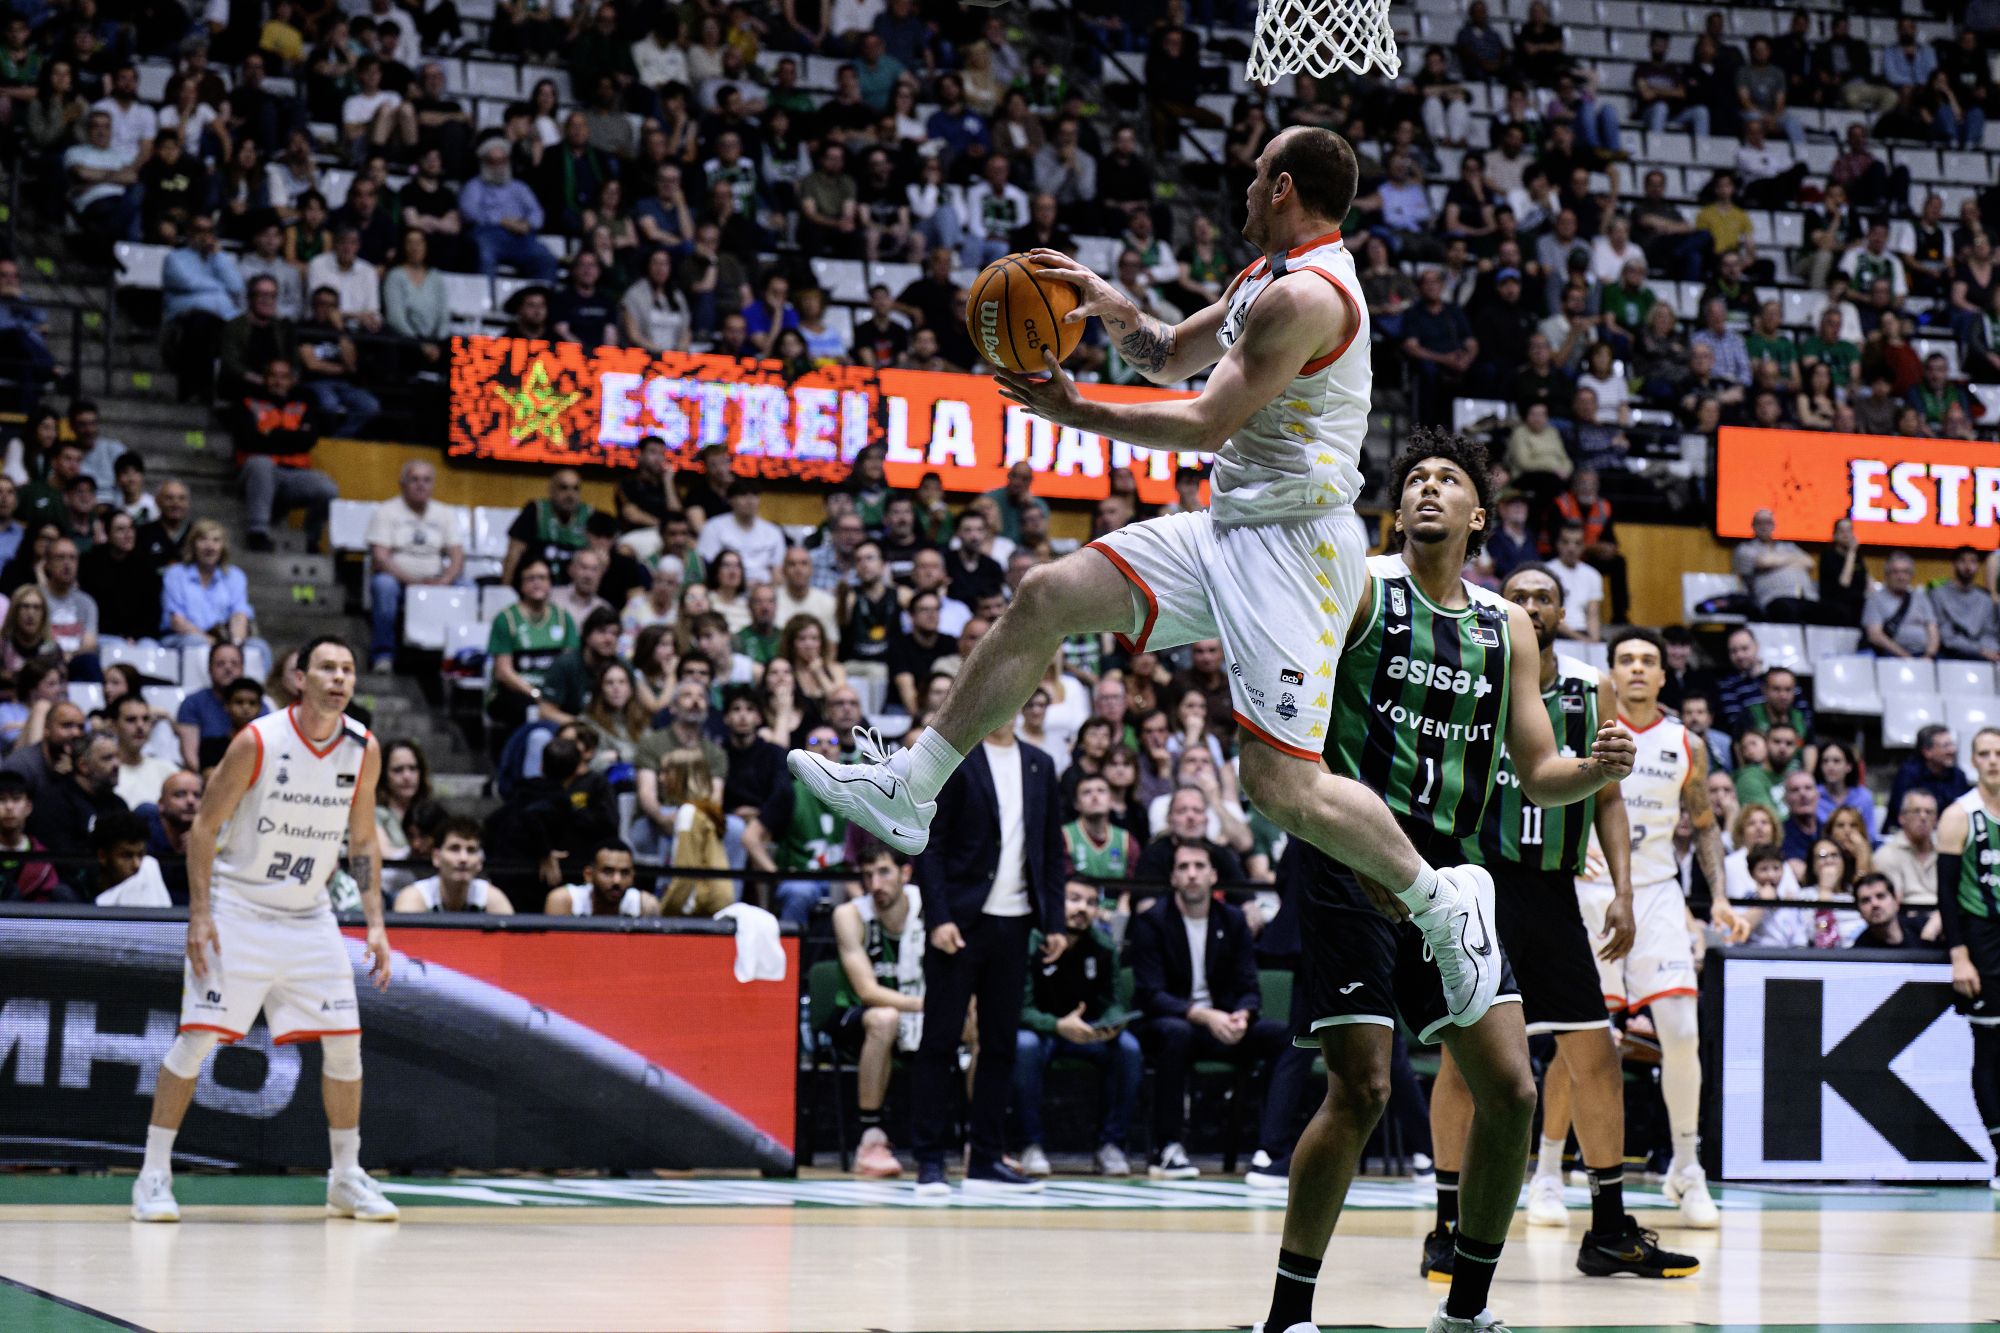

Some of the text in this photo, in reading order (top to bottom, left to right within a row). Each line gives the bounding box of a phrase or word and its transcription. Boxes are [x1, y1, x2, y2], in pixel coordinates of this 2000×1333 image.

[1023, 319, 1041, 349] acb
[1004, 405, 1214, 480] DA
[1281, 674, 1299, 684] acb
[1376, 699, 1492, 742] JOVENTUT
[1418, 758, 1435, 804] 1
[1521, 806, 1543, 845] 11
[266, 851, 316, 886] 24
[1762, 977, 1988, 1162] K
